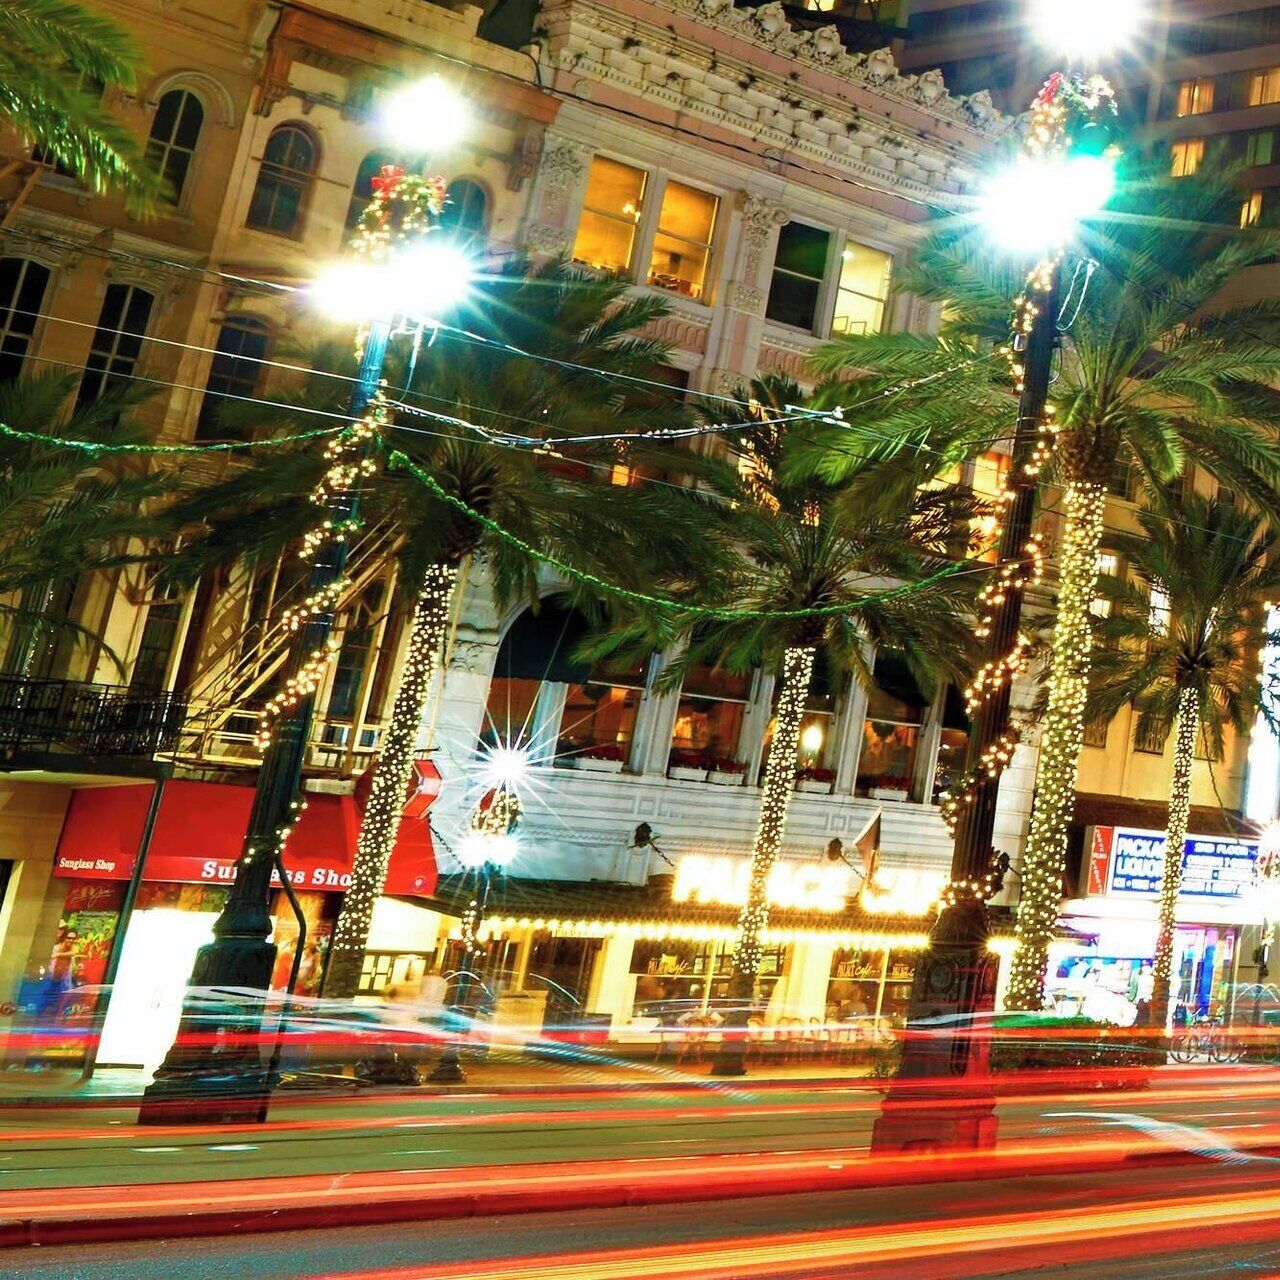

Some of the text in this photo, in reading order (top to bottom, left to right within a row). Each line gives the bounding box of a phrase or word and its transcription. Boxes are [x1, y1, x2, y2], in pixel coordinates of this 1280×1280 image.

[59, 857, 116, 873] Sunglass Shop
[311, 868, 353, 887] Sho
